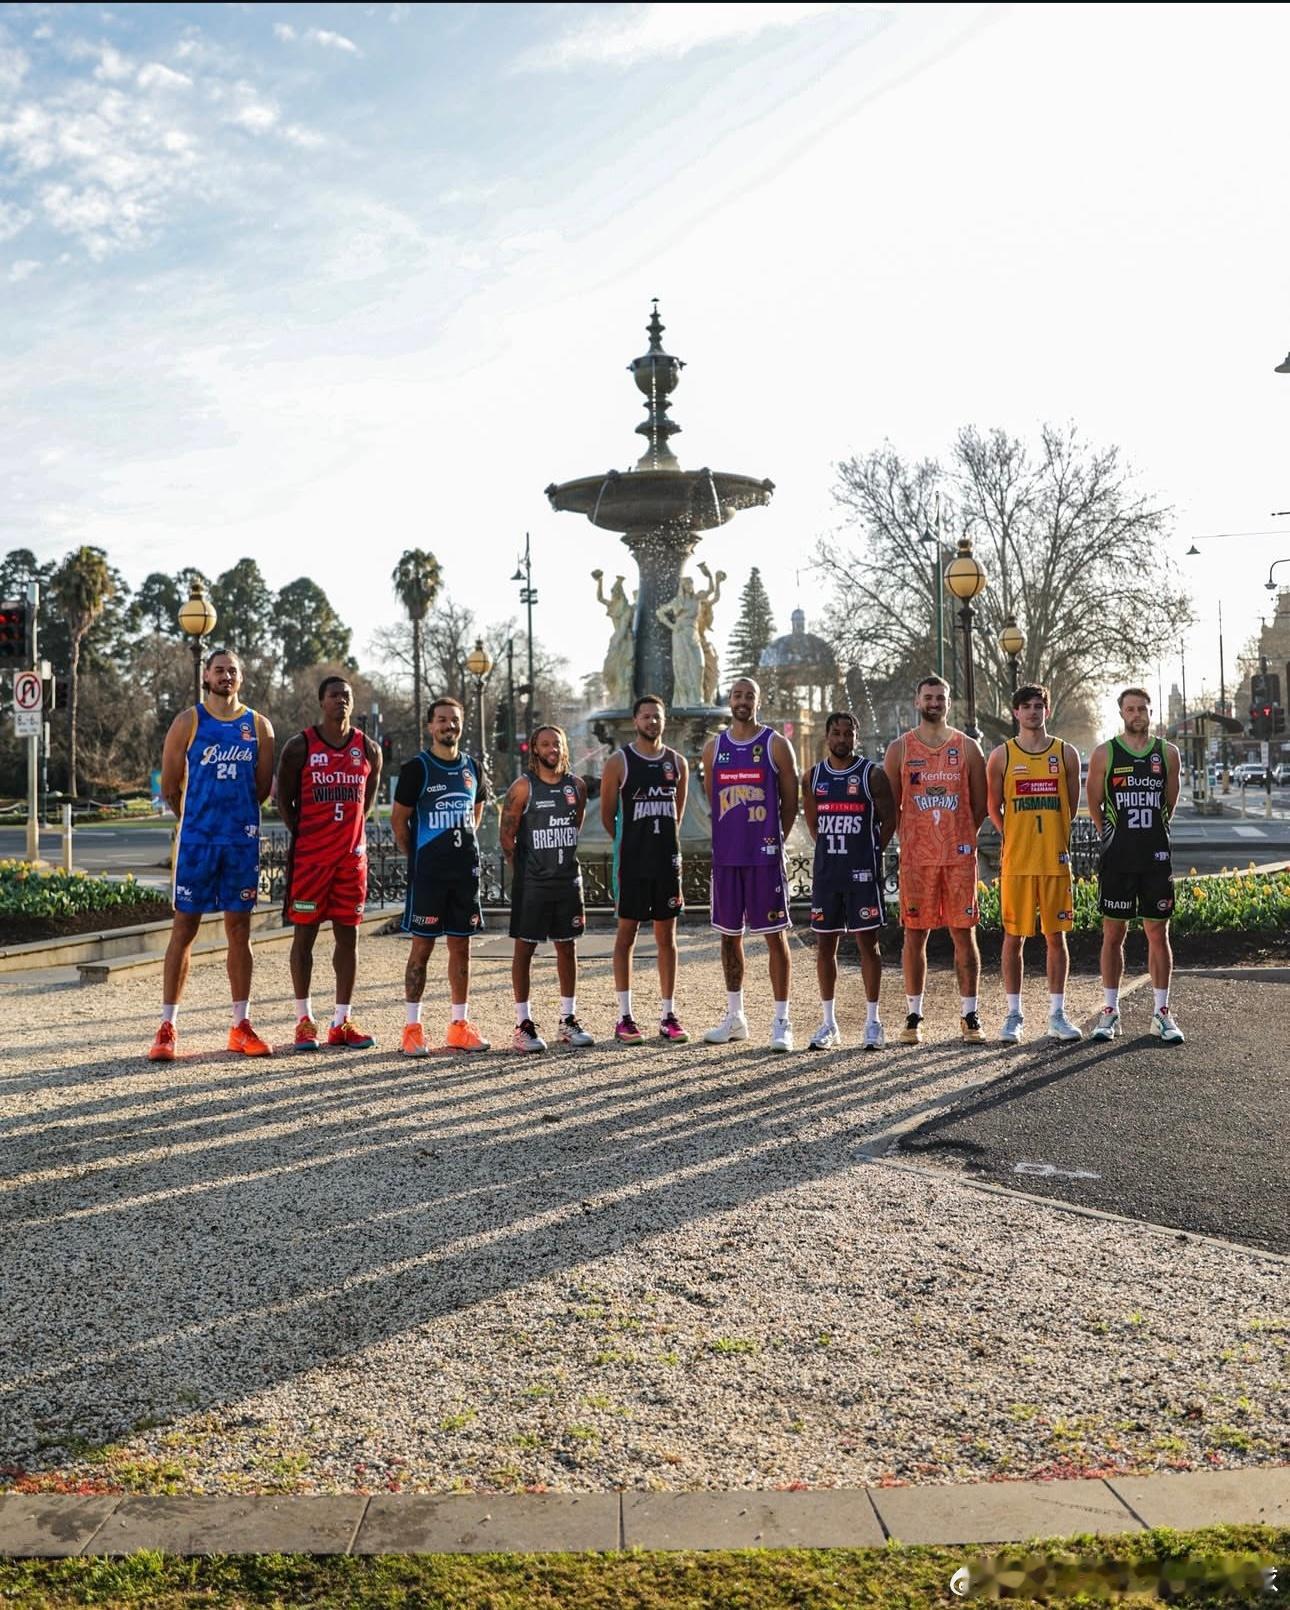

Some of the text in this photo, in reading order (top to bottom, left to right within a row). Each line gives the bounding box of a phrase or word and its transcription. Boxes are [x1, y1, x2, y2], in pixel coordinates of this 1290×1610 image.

[200, 744, 253, 766] Bullets
[217, 763, 237, 780] 24
[718, 784, 765, 822] KINGS
[914, 794, 960, 811] TAIPANS
[334, 803, 345, 821] 5
[549, 815, 570, 827] bnz
[747, 805, 767, 822] 10
[932, 809, 941, 826] 9
[1127, 809, 1153, 829] 20
[653, 819, 660, 834] 1
[817, 815, 863, 834] SIXERS
[1036, 815, 1043, 834] 1
[453, 829, 462, 848] 3
[826, 834, 848, 854] 11
